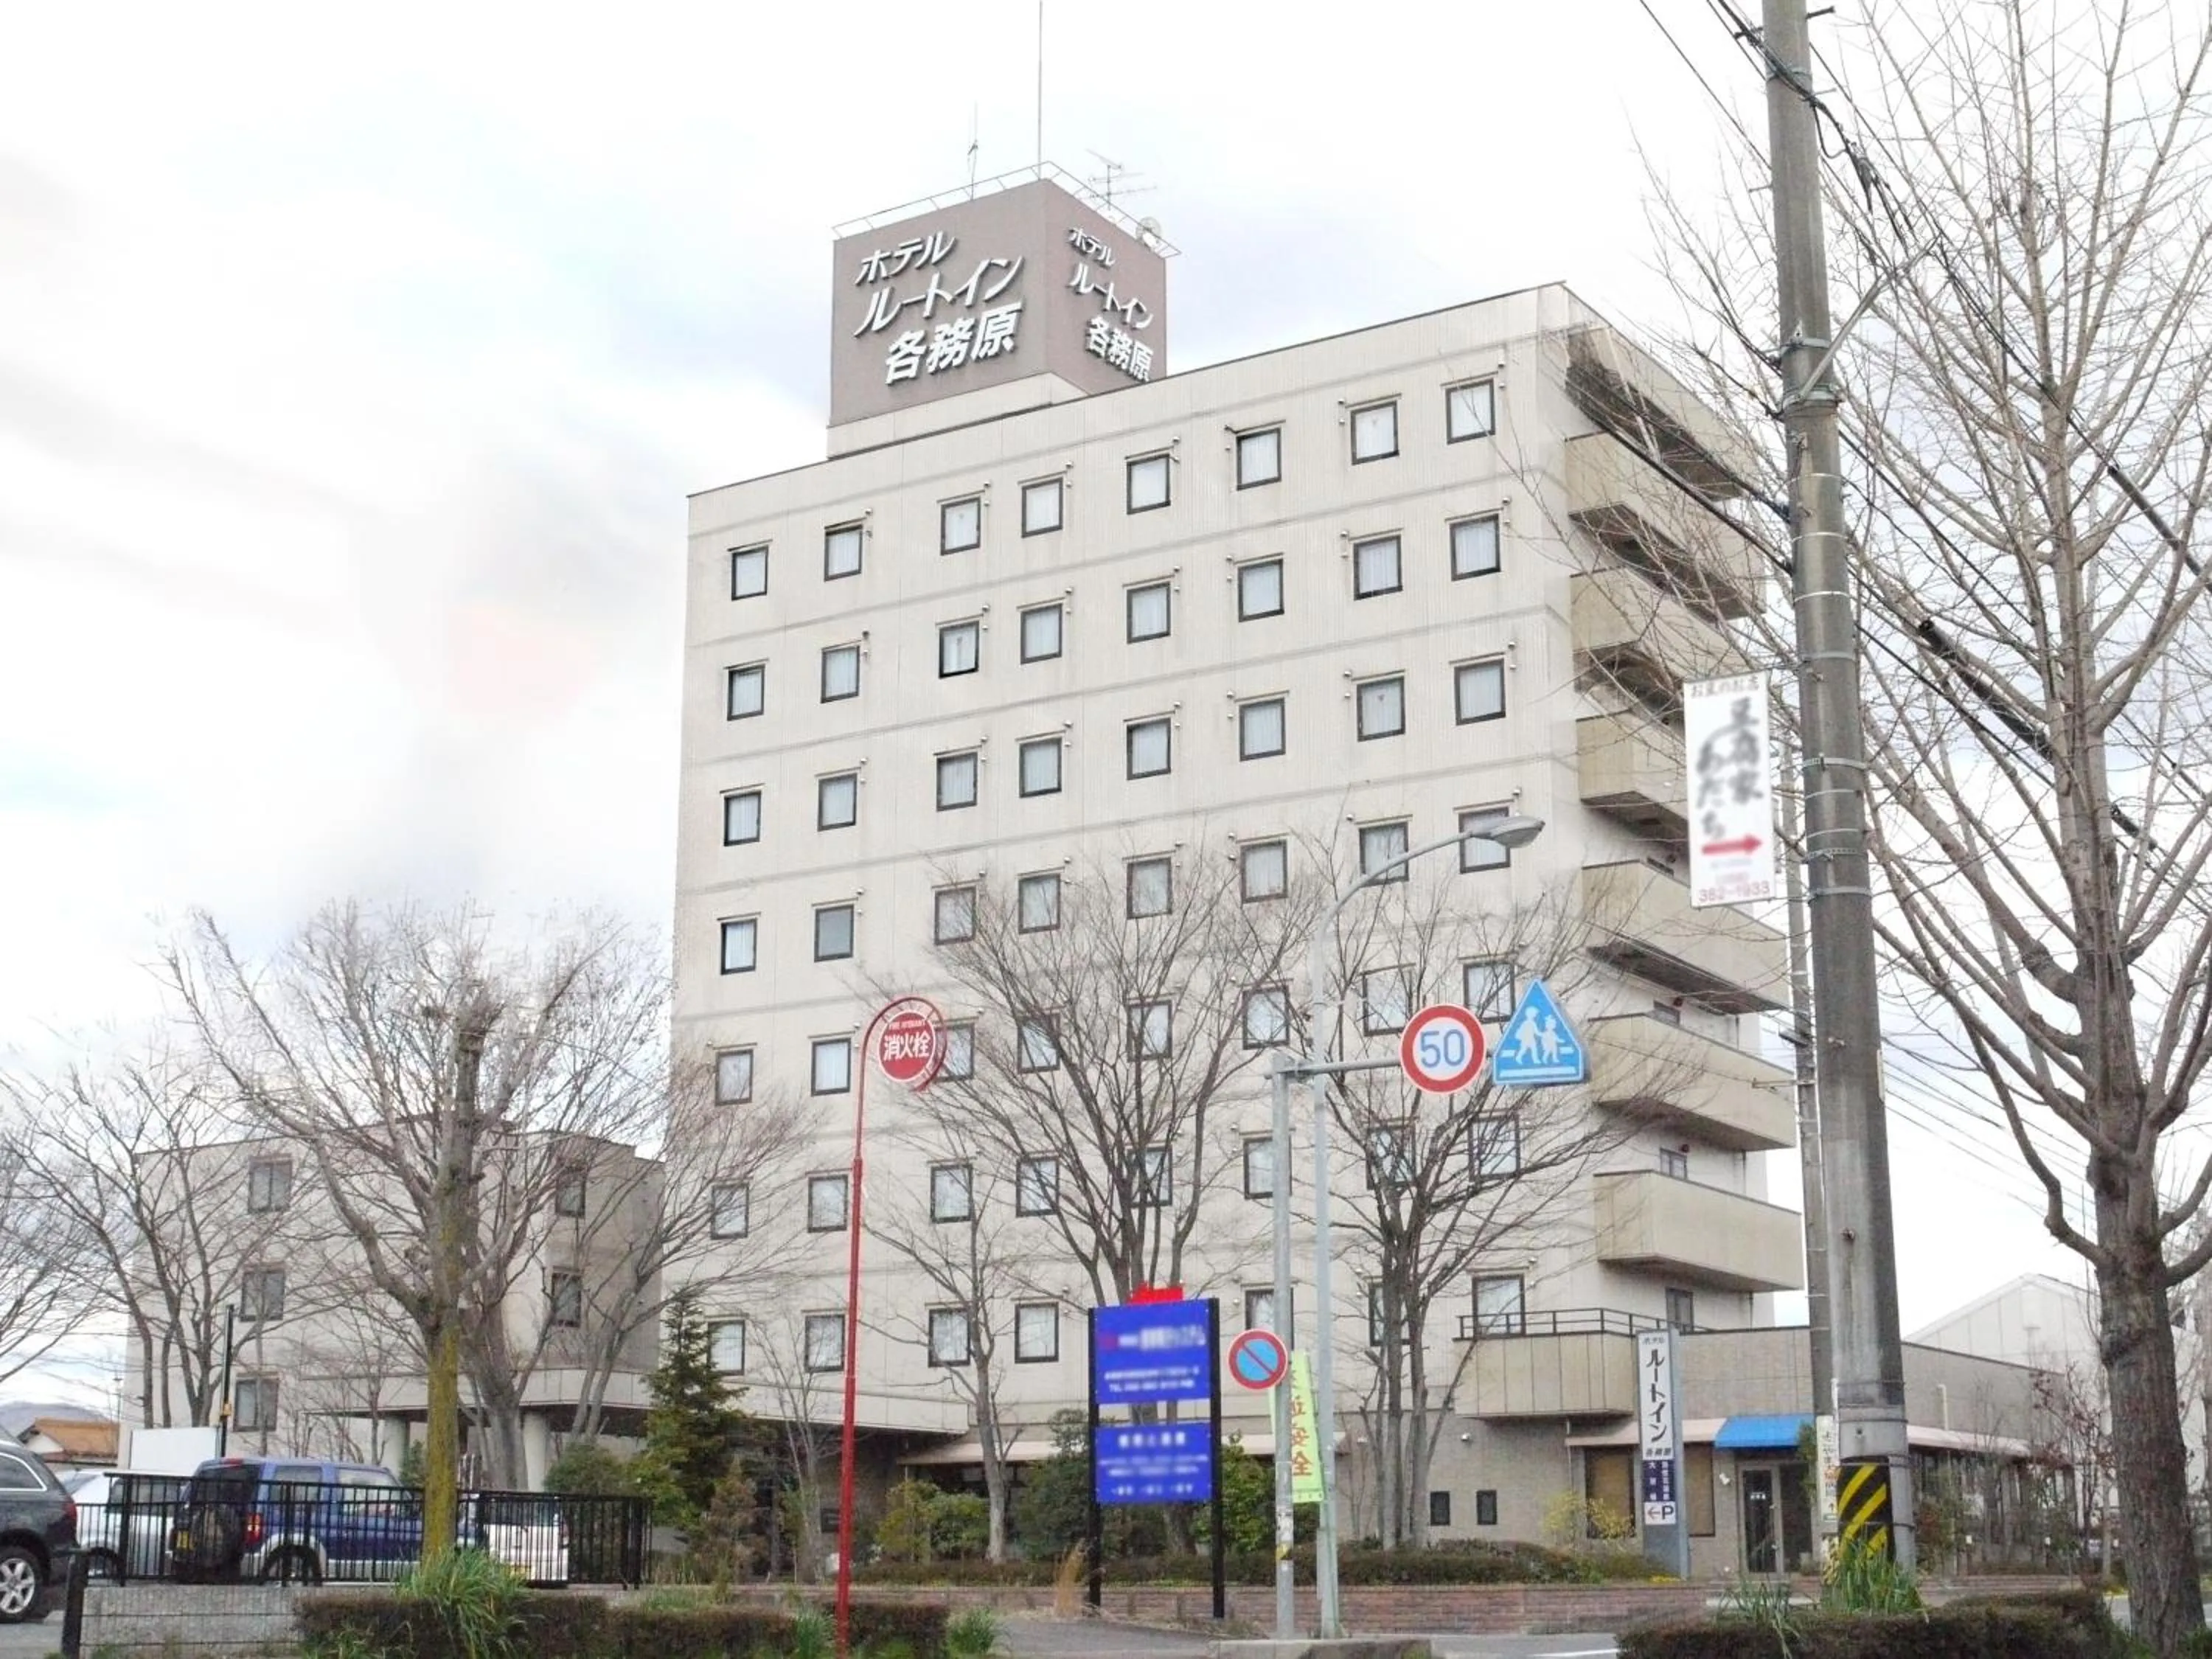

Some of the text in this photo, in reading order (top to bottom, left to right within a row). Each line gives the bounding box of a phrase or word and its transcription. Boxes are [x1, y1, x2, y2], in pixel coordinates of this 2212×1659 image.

[855, 231, 957, 285] ホテル
[1068, 227, 1116, 267] ホテル
[854, 255, 1023, 337] ルートイン
[1071, 263, 1154, 329] ルートイン
[886, 301, 1023, 384] 各務原
[1085, 317, 1154, 383] 各務原
[883, 1031, 931, 1061] 消火栓
[1420, 1029, 1466, 1068] 50
[1645, 1349, 1666, 1443] ルートイン
[1661, 1505, 1674, 1520] P
